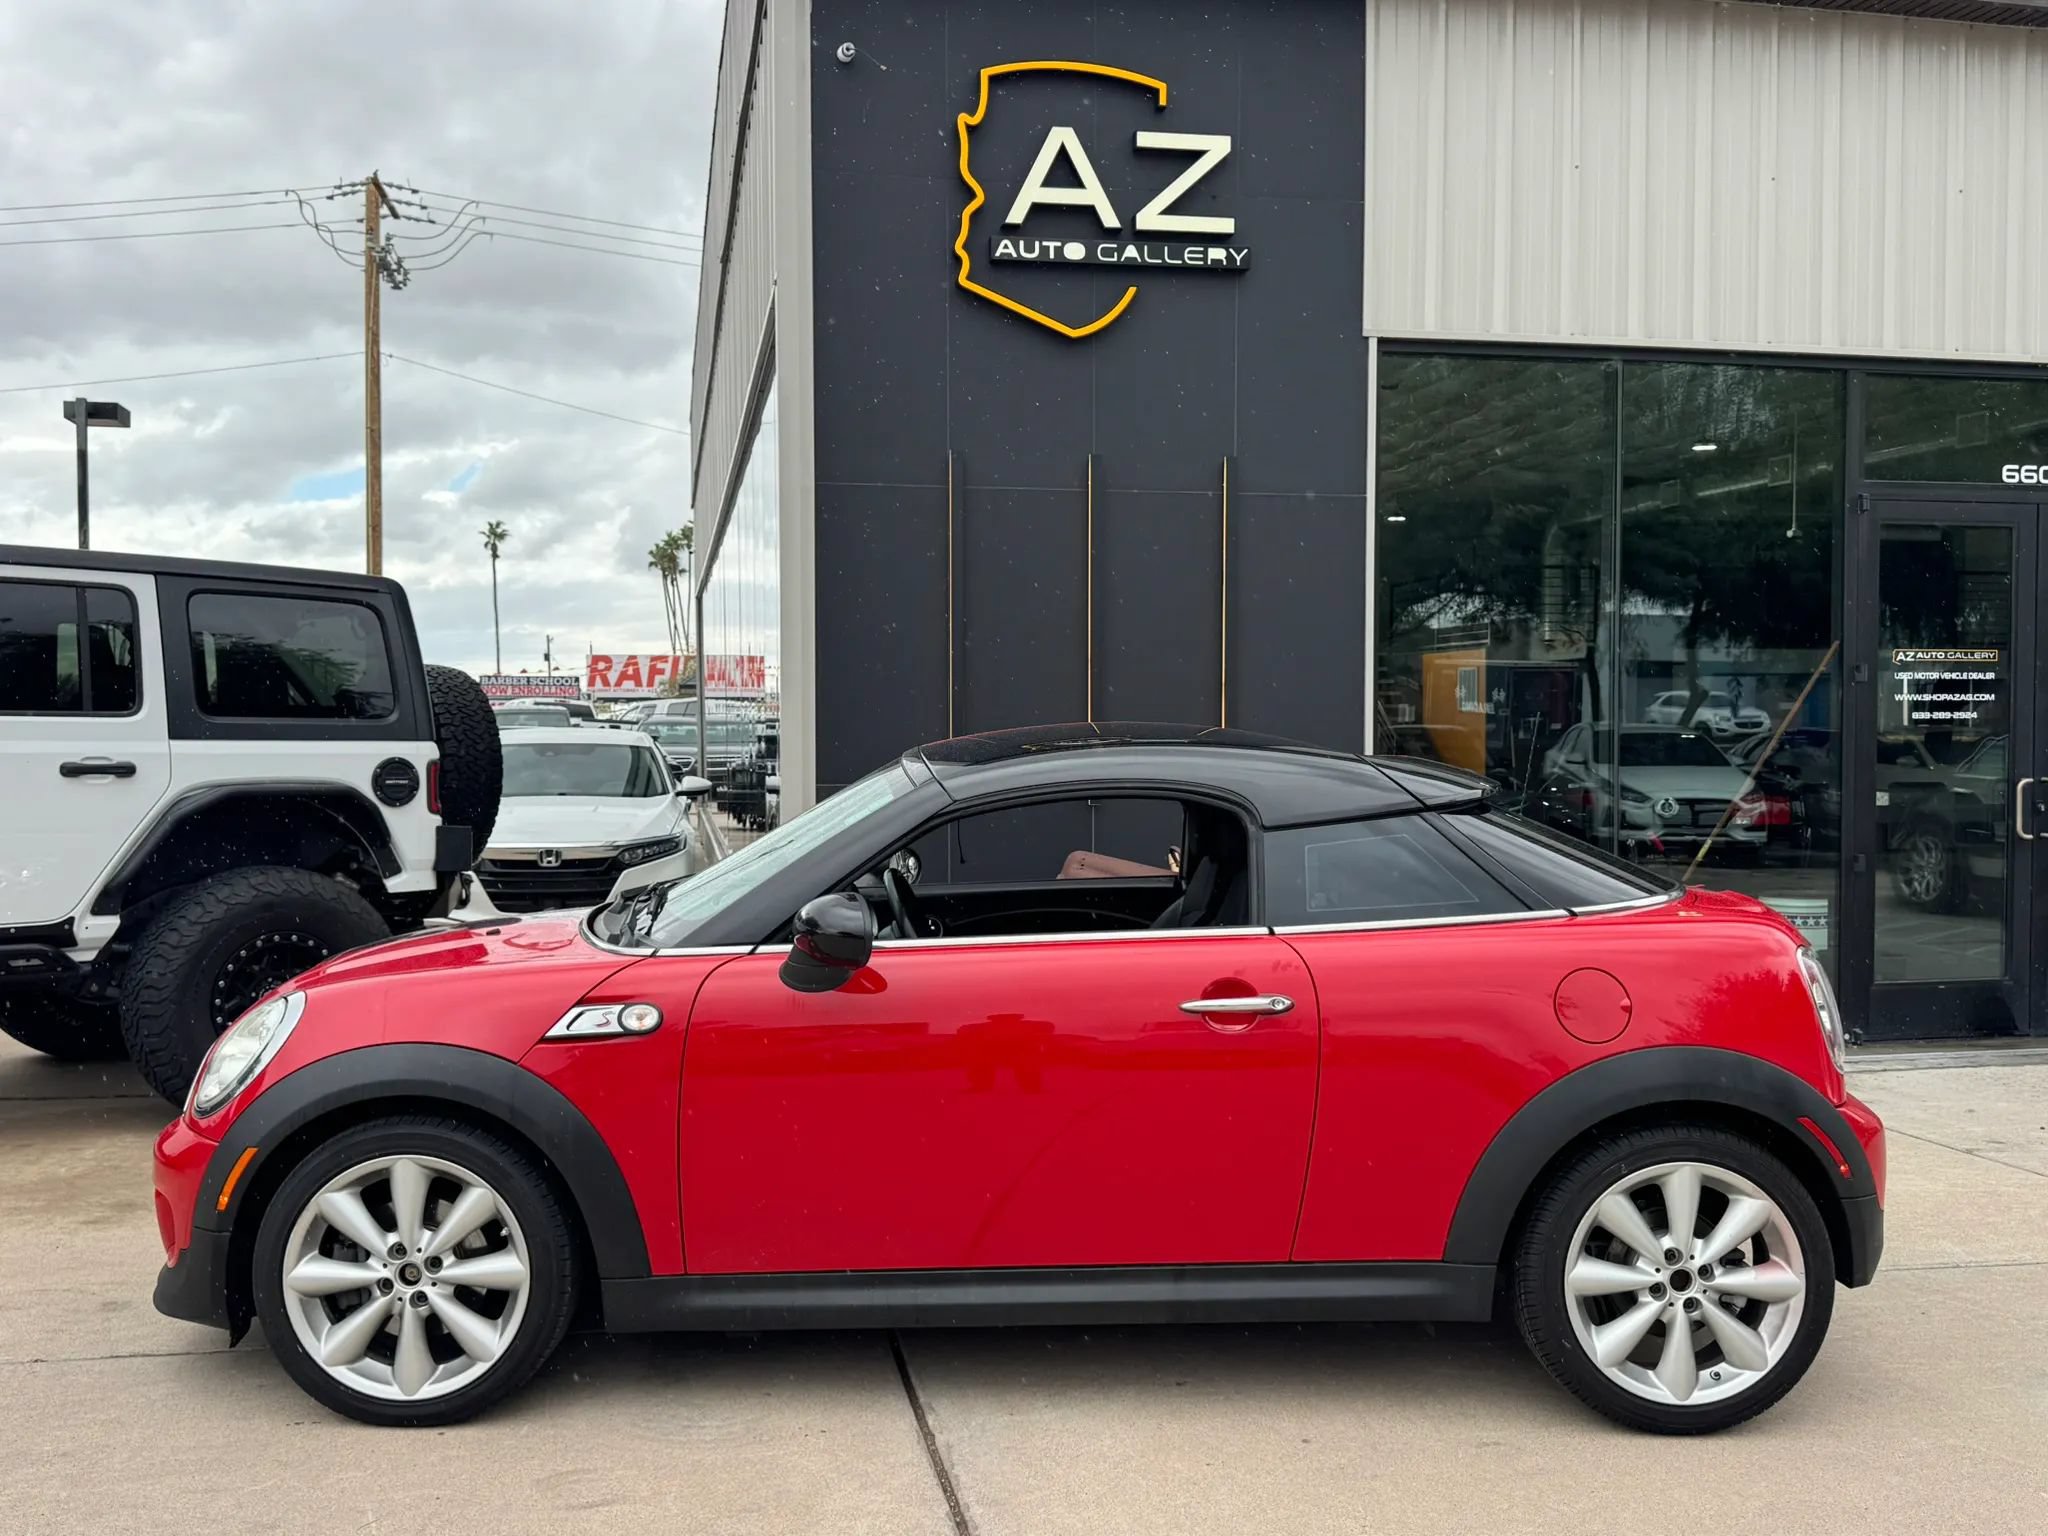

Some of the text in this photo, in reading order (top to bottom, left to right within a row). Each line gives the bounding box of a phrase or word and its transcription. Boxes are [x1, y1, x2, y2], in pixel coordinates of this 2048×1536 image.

[1004, 126, 1236, 234] AZ
[995, 238, 1249, 266] AUTO GALLERY
[1896, 652, 1915, 661] AZ
[481, 676, 579, 686] BARBER SCHOOL
[1940, 672, 1967, 680] VEHICLE
[1968, 672, 1995, 680] DEALER
[481, 686, 508, 696] NOW
[1894, 693, 1995, 701] WWW.SHOPAZAG.COM
